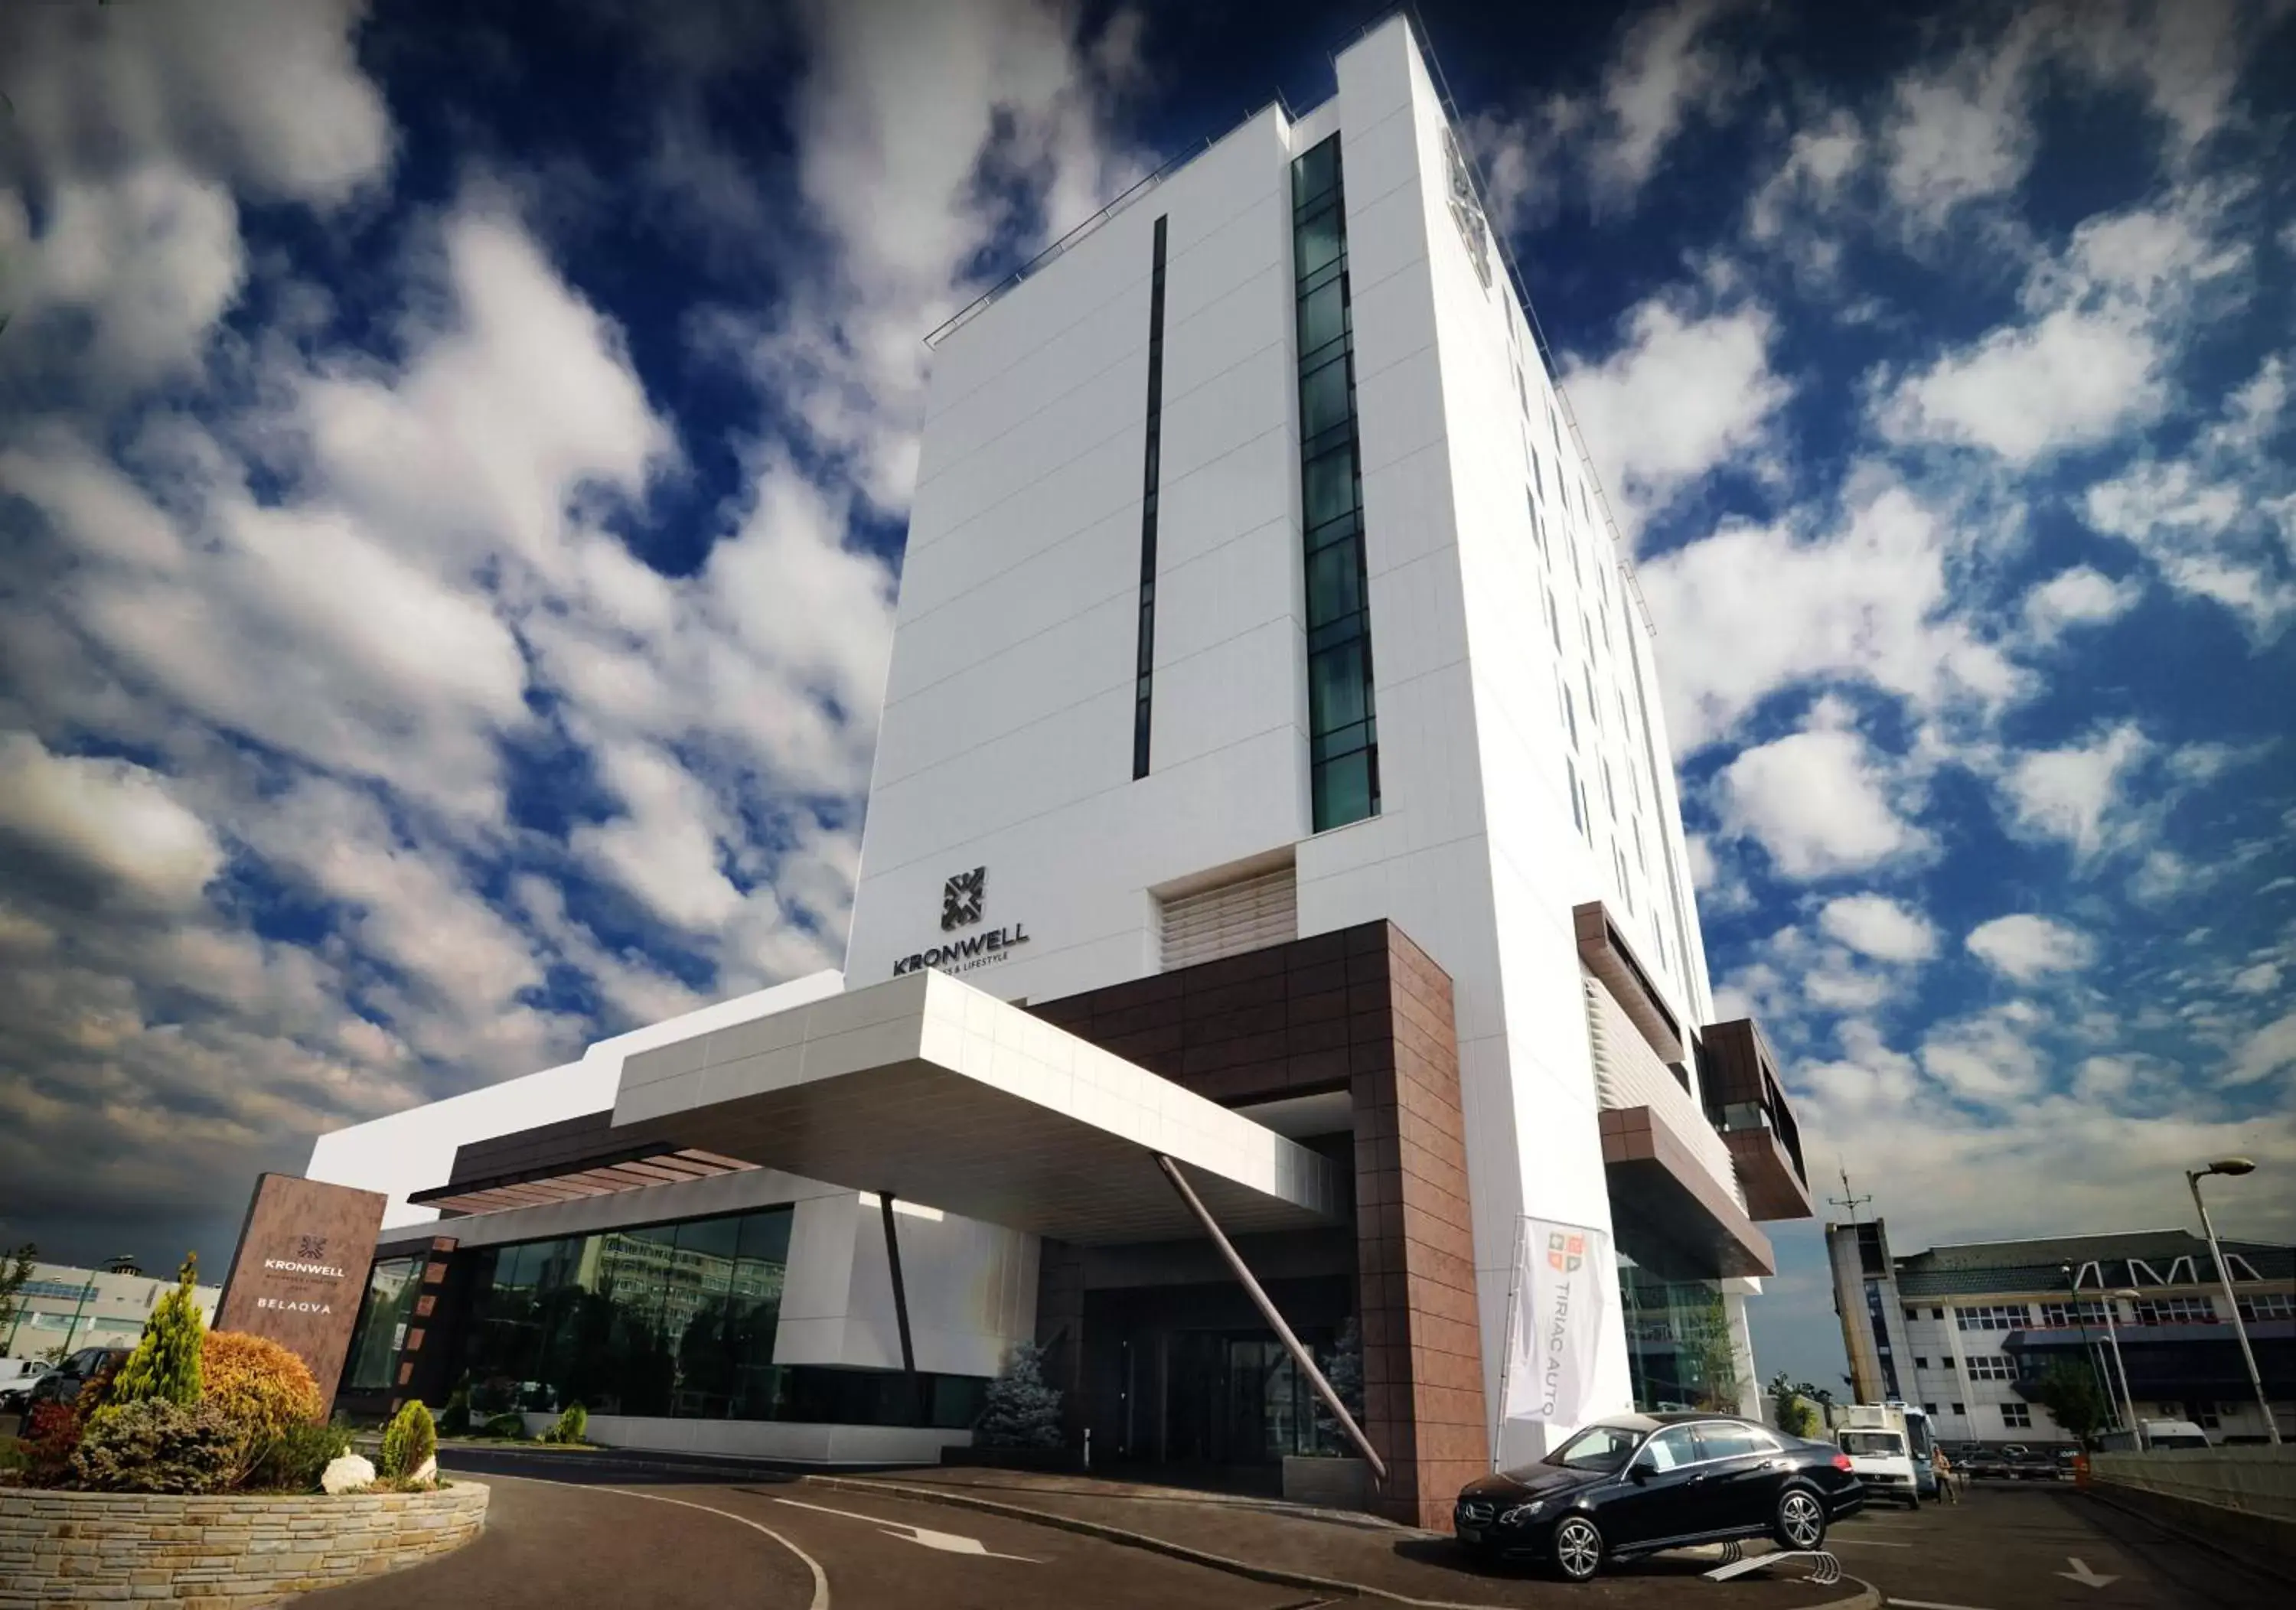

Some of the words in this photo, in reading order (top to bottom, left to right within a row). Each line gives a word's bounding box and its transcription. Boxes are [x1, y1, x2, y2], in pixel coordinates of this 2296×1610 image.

[893, 923, 1030, 976] KRONWELL
[964, 952, 1008, 971] LIFESTYLE
[265, 1259, 344, 1277] KRONWELL
[1549, 1281, 1570, 1352] TIRIAC
[1542, 1357, 1561, 1416] AUTO
